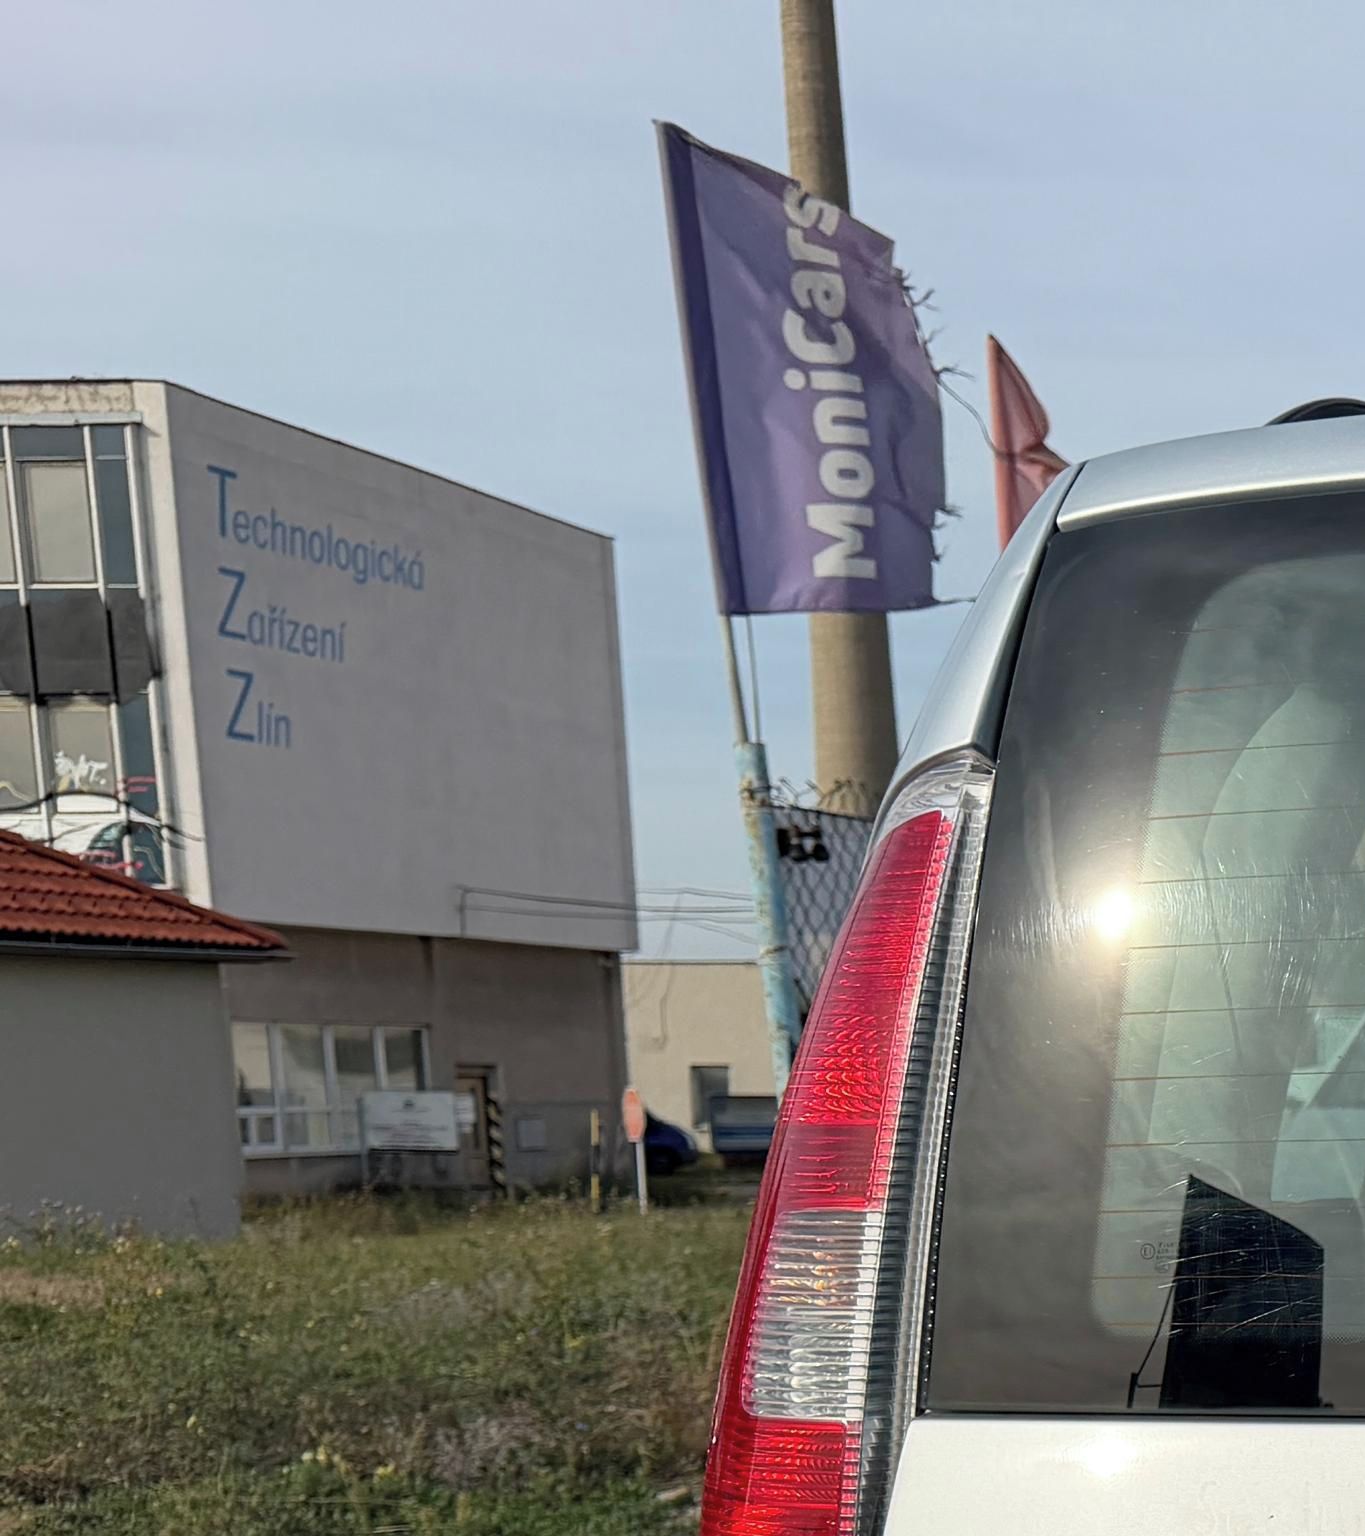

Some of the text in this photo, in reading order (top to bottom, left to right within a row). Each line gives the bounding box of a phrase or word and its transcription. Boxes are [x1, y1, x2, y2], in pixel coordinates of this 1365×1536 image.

[782, 181, 878, 580] MoniCars
[207, 464, 424, 590] Technologická
[216, 567, 346, 663] Zařízení
[225, 669, 292, 749] Zlín
